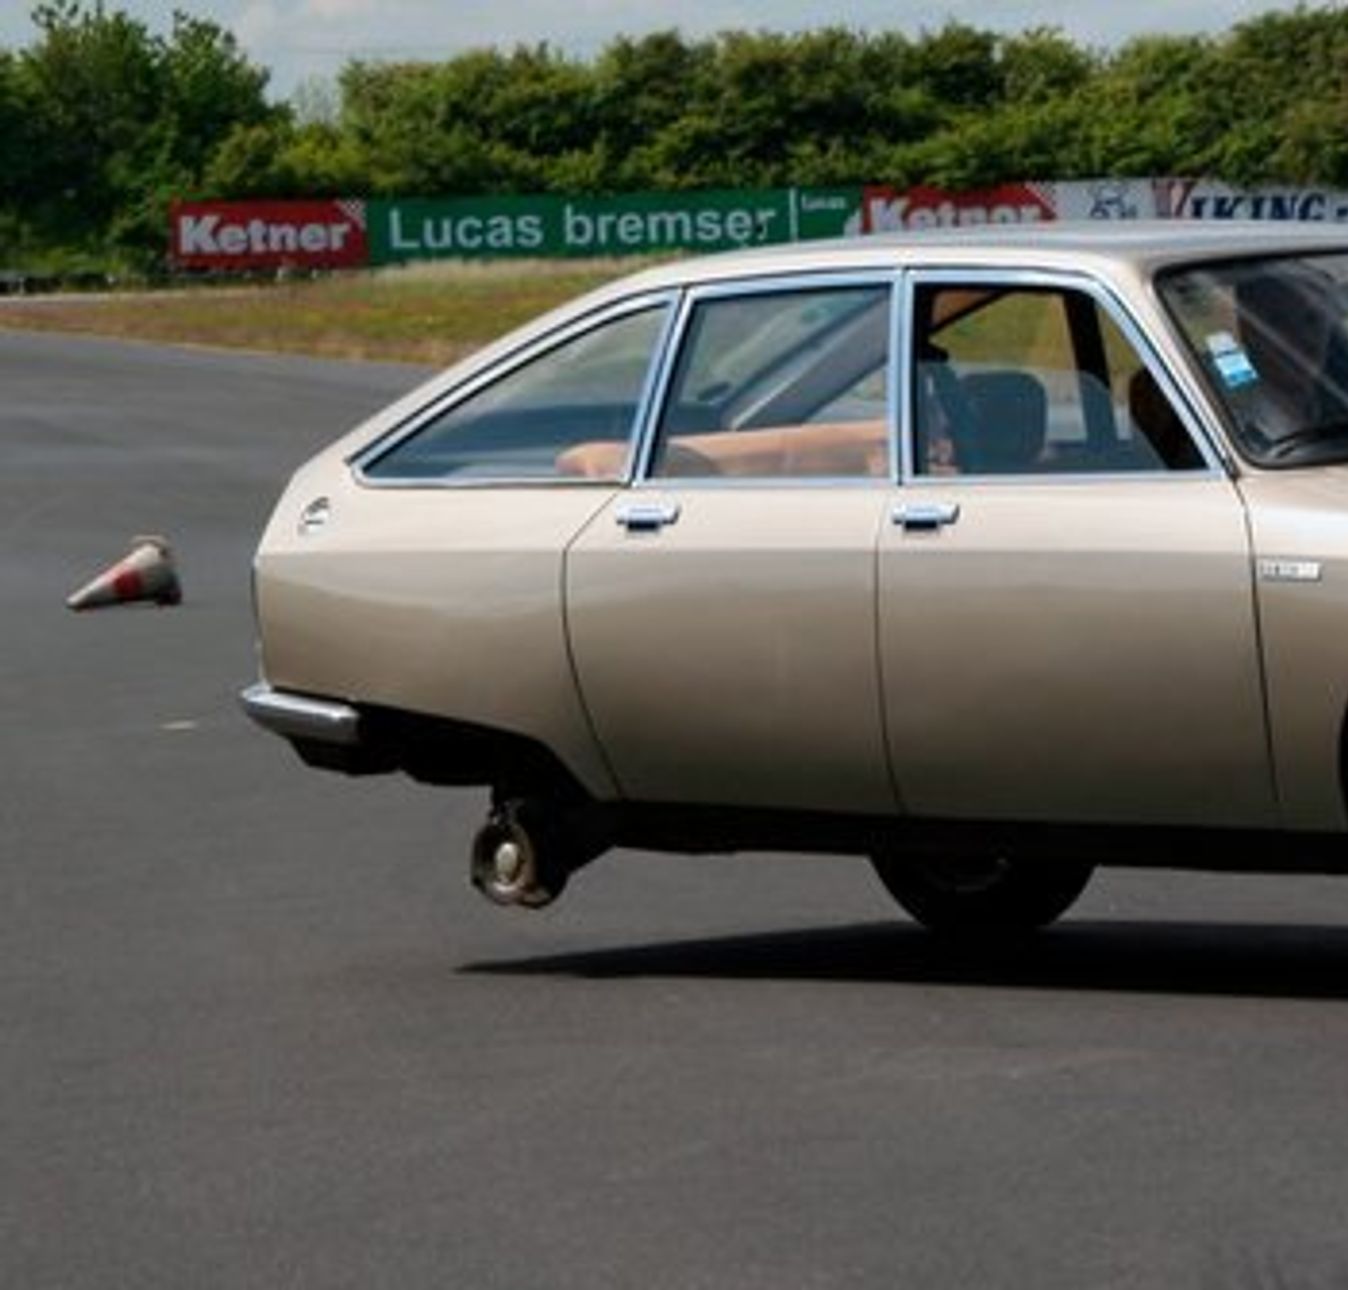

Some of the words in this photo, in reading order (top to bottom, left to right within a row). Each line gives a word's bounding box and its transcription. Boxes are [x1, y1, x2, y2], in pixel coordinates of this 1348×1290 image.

[179, 213, 350, 254] Ketner
[388, 208, 543, 249] Lucas
[564, 204, 775, 246] bremser
[870, 197, 1041, 231] Ketner
